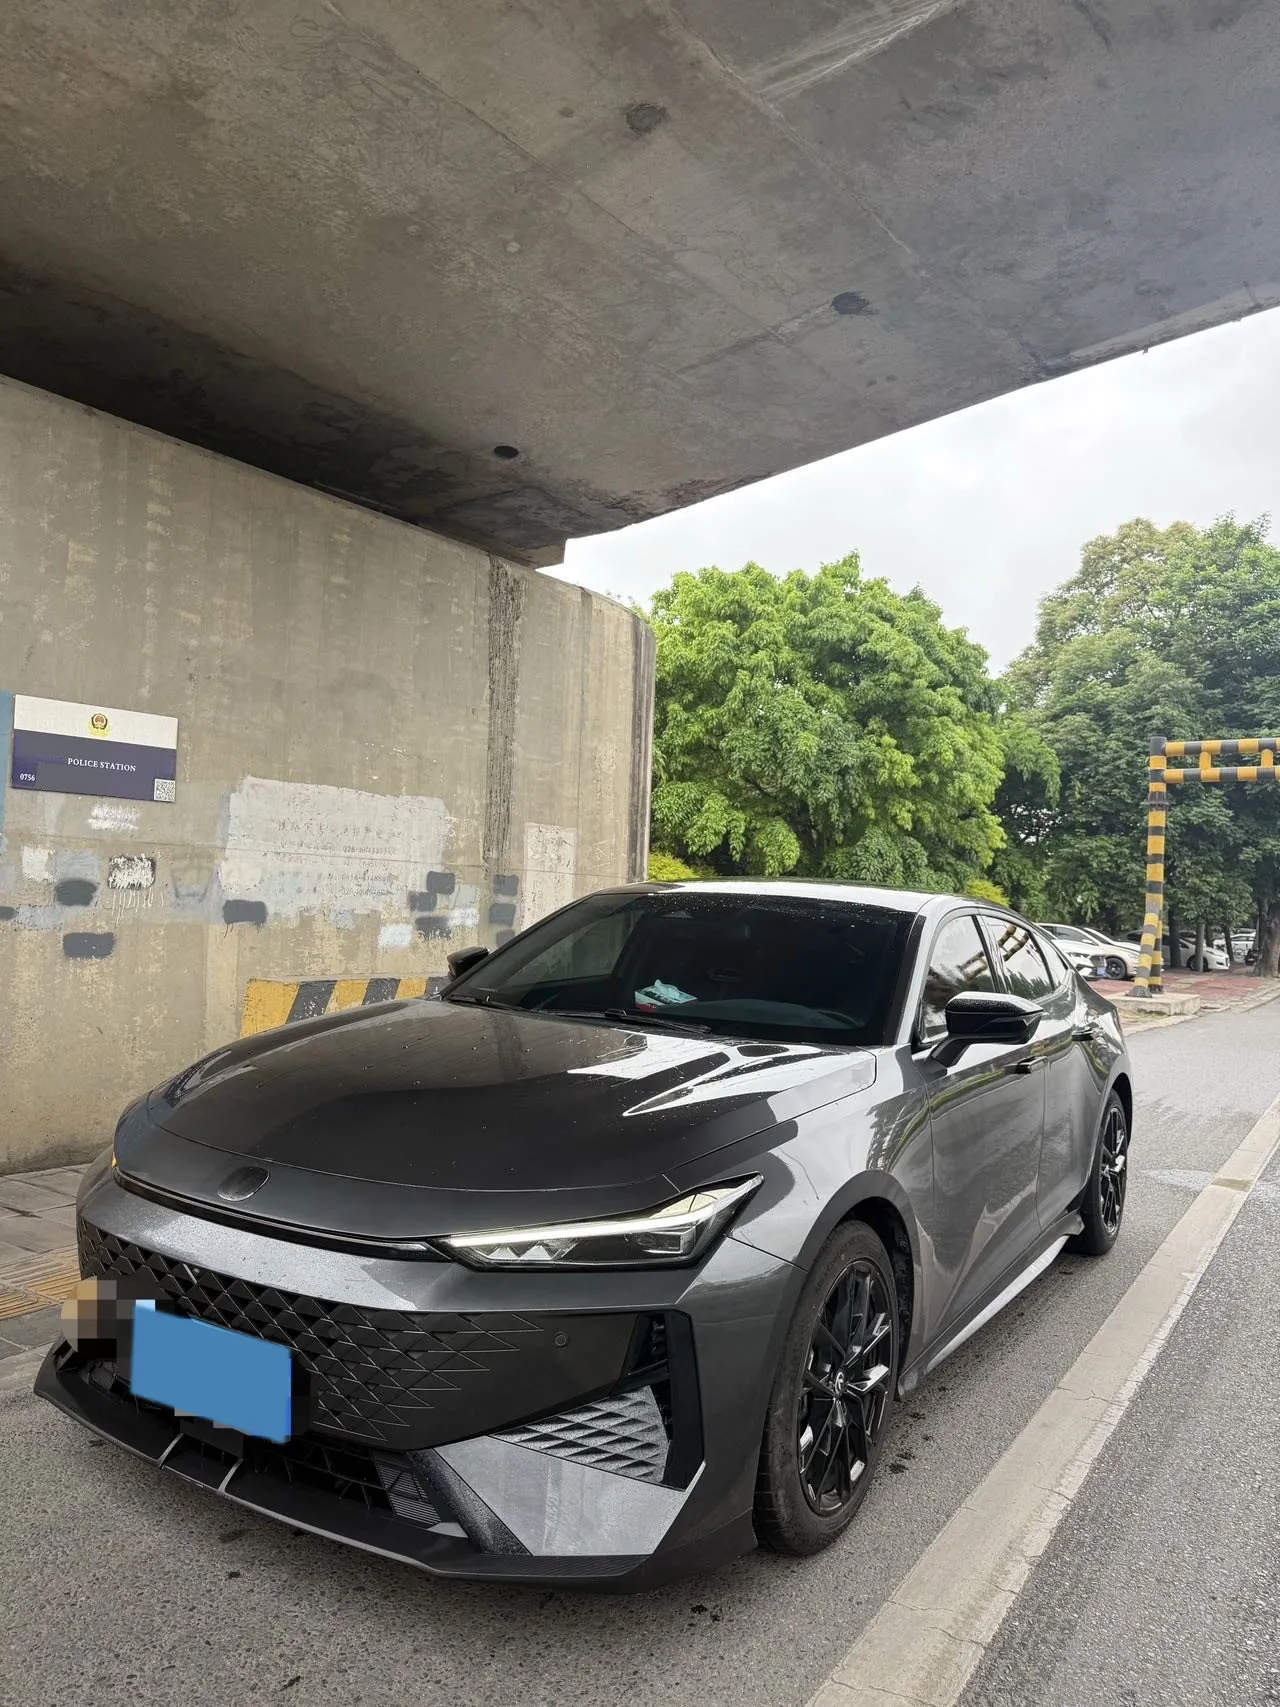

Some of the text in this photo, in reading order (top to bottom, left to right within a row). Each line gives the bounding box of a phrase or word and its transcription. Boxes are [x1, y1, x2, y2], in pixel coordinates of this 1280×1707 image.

[67, 757, 136, 772] POLICE STATION
[19, 773, 36, 782] 0756
